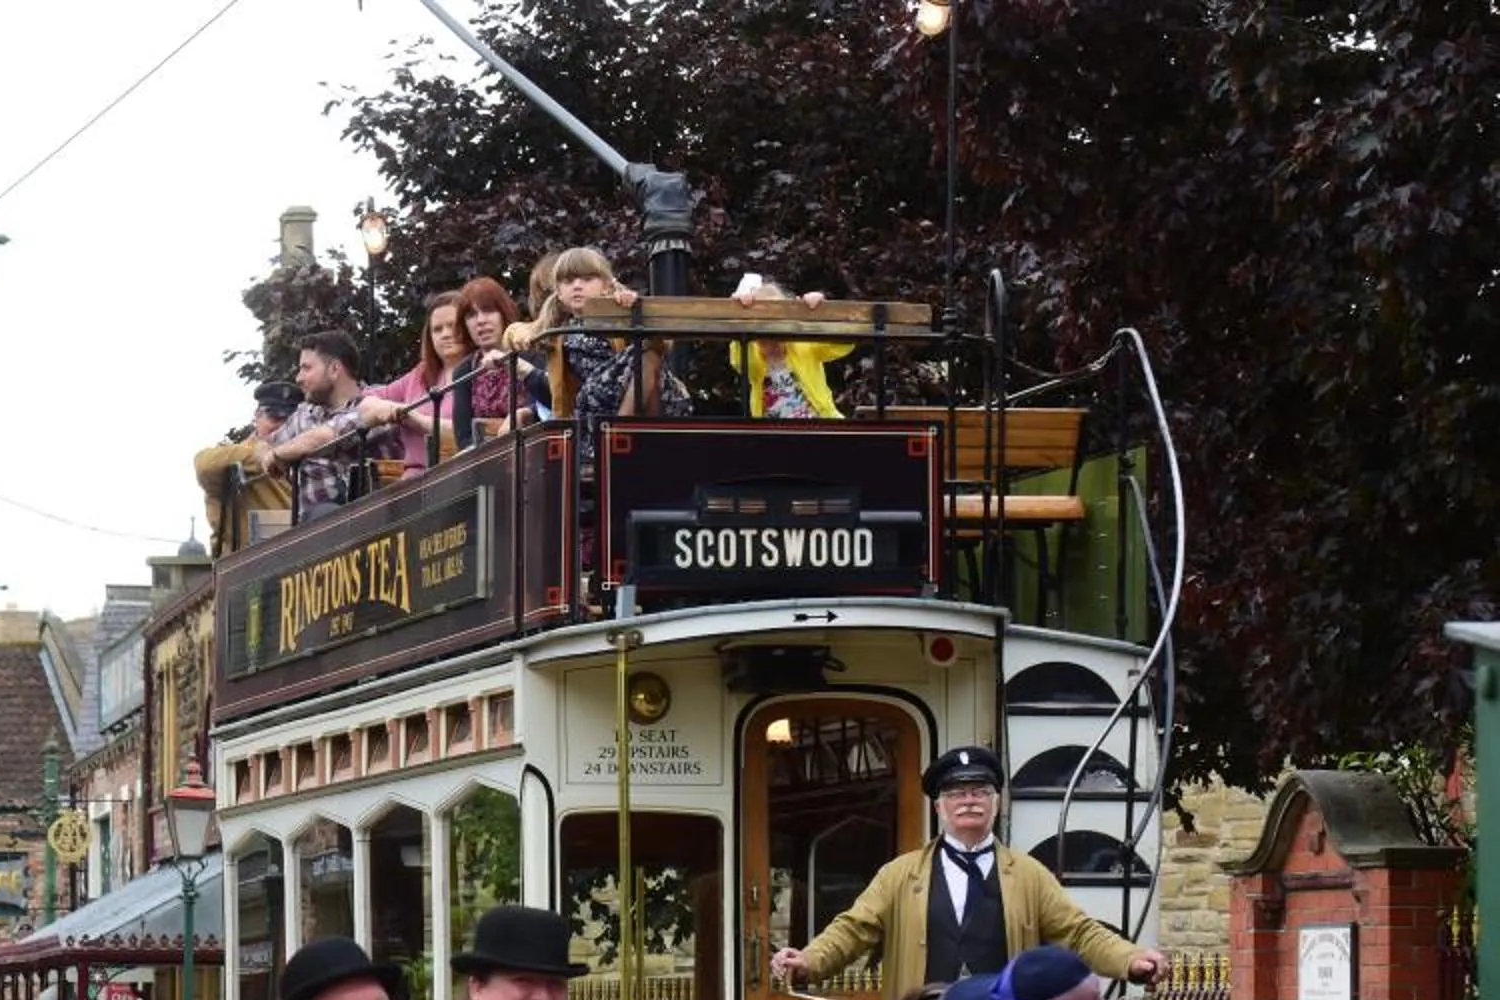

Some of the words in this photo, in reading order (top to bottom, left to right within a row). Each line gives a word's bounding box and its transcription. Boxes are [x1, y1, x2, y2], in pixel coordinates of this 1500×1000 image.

[674, 528, 873, 569] SCOTSWOOD
[279, 548, 361, 654] RINGTONS
[367, 531, 411, 614] TEA
[639, 729, 676, 742] SEAT
[598, 746, 617, 759] 29
[618, 746, 689, 759] PSTAIRS
[584, 762, 601, 775] 24
[607, 762, 701, 775] DWNSTAIRS
